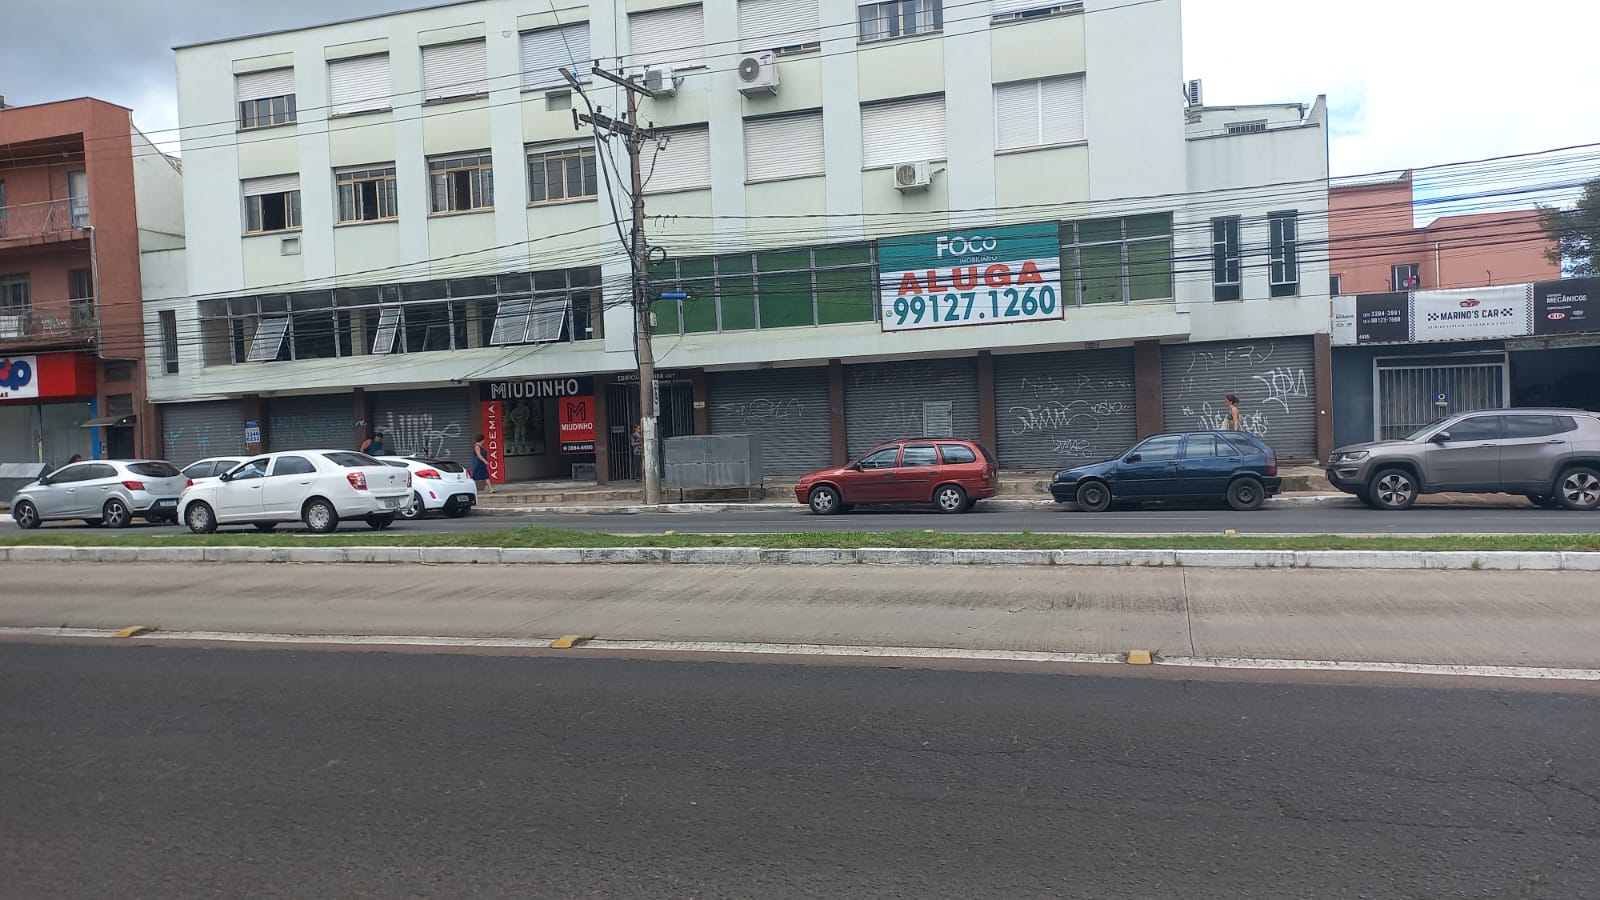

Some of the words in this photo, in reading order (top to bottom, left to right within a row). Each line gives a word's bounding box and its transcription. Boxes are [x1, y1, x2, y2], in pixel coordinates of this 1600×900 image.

[897, 261, 1044, 296] ALUGA
[893, 285, 1056, 326] 99127.1260
[1440, 310, 1480, 321] MARINO'S
[1481, 308, 1499, 318] CAR
[491, 378, 579, 400] MIUDINHO
[561, 422, 593, 431] MIUDINHO
[487, 404, 499, 480] ACADEMIA
